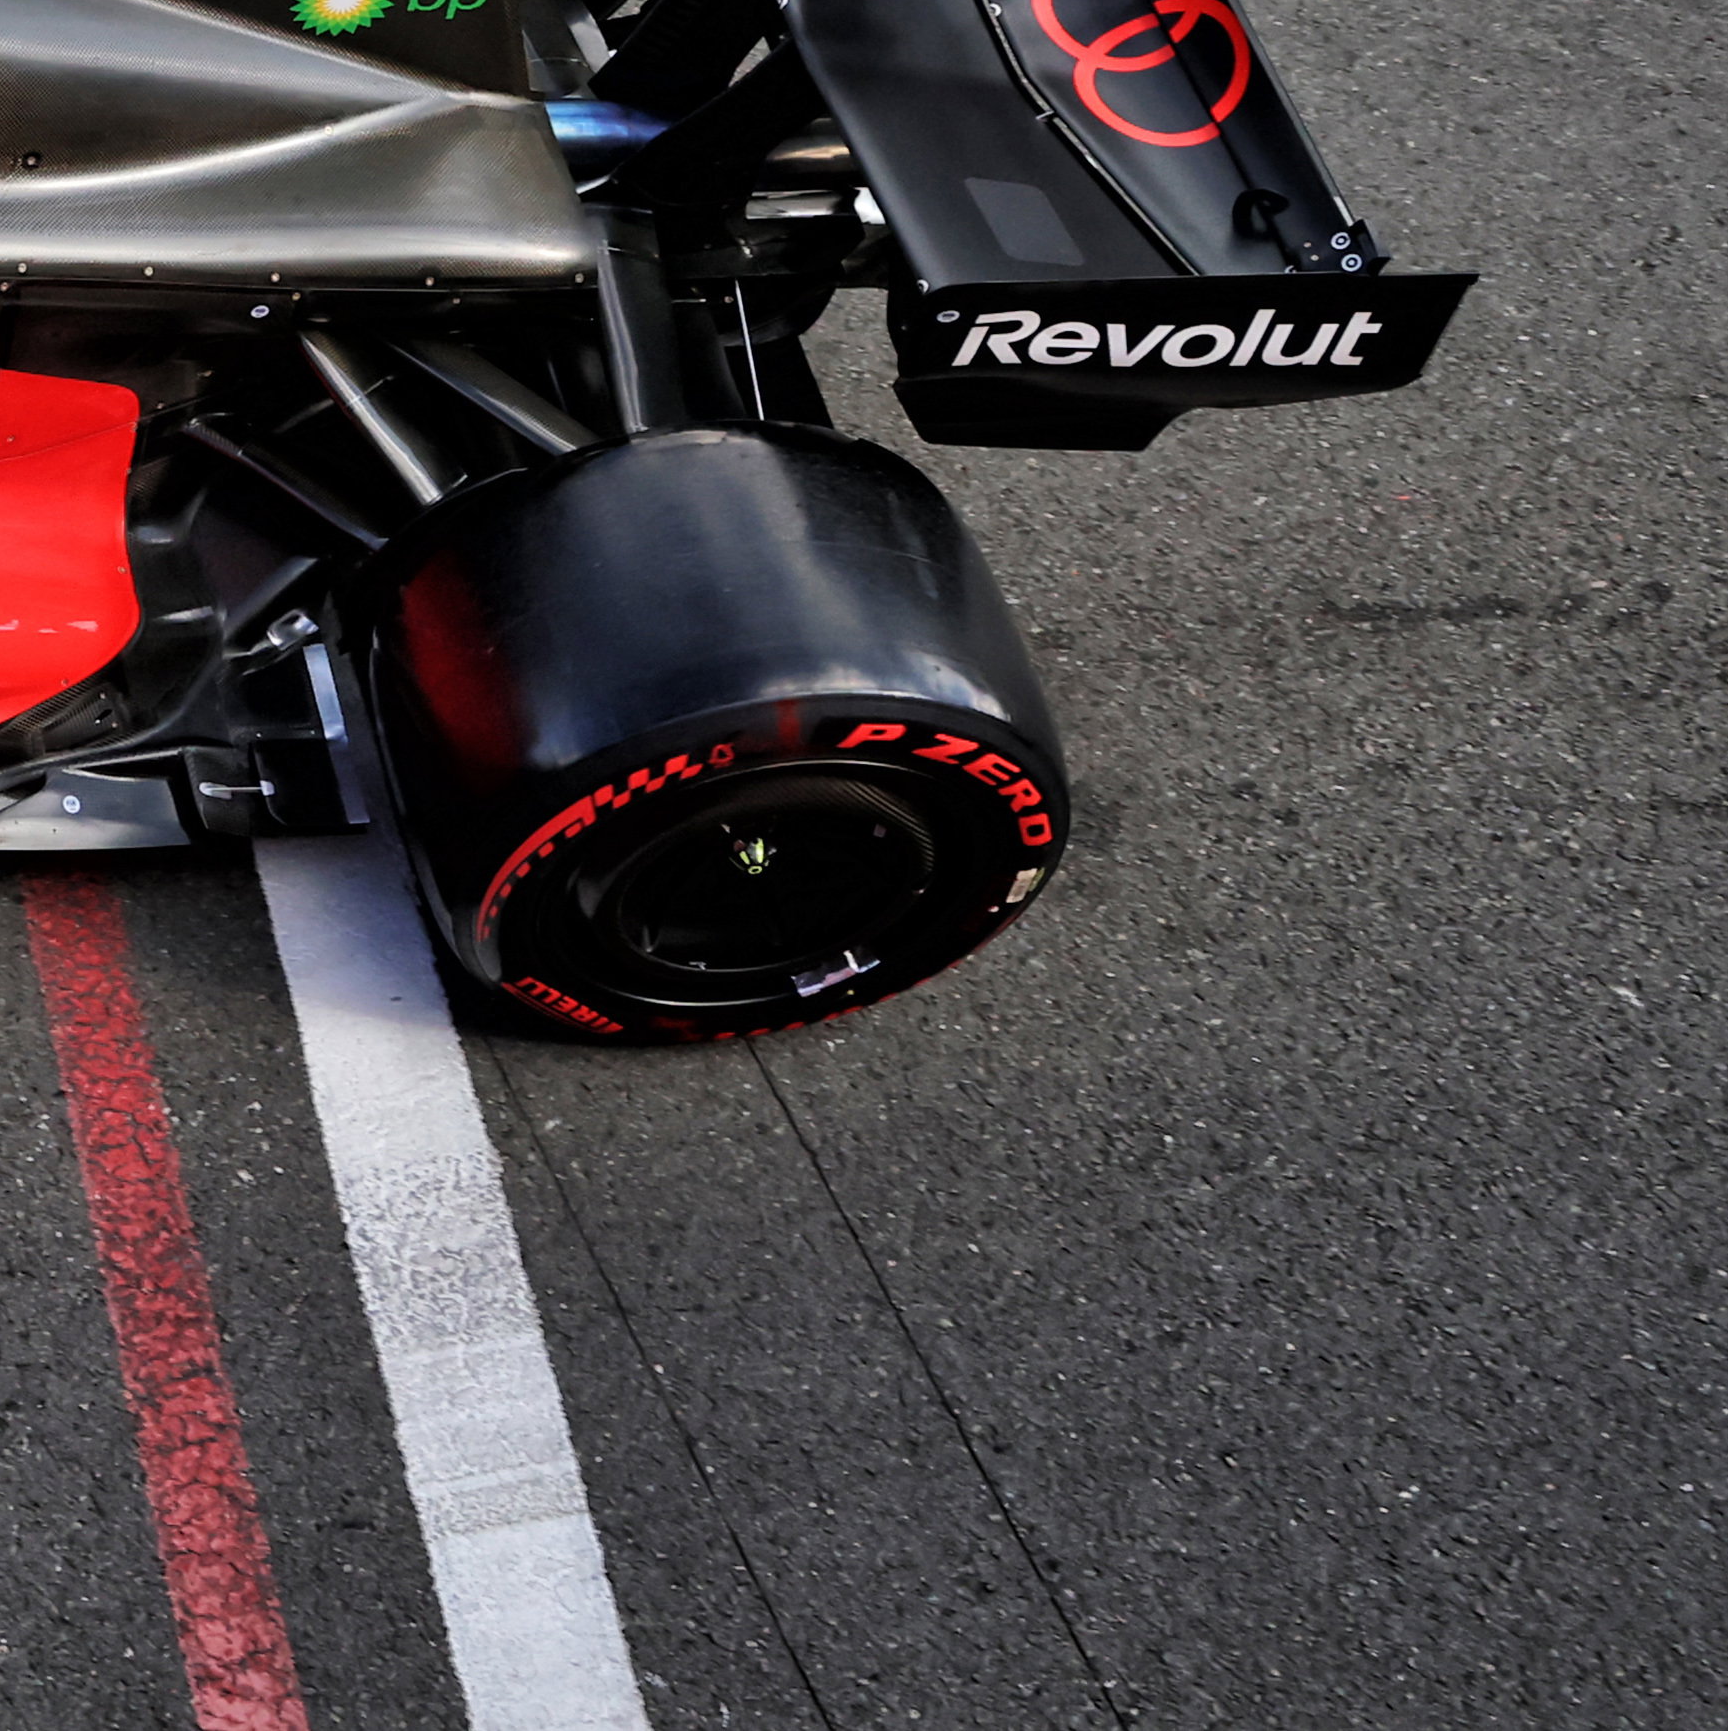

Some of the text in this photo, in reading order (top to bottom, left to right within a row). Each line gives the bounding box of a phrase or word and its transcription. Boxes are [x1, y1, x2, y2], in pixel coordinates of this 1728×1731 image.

[951, 307, 1383, 368] Revolut
[836, 721, 1053, 848] P ZERO
[500, 975, 626, 1037] PIRELLI
